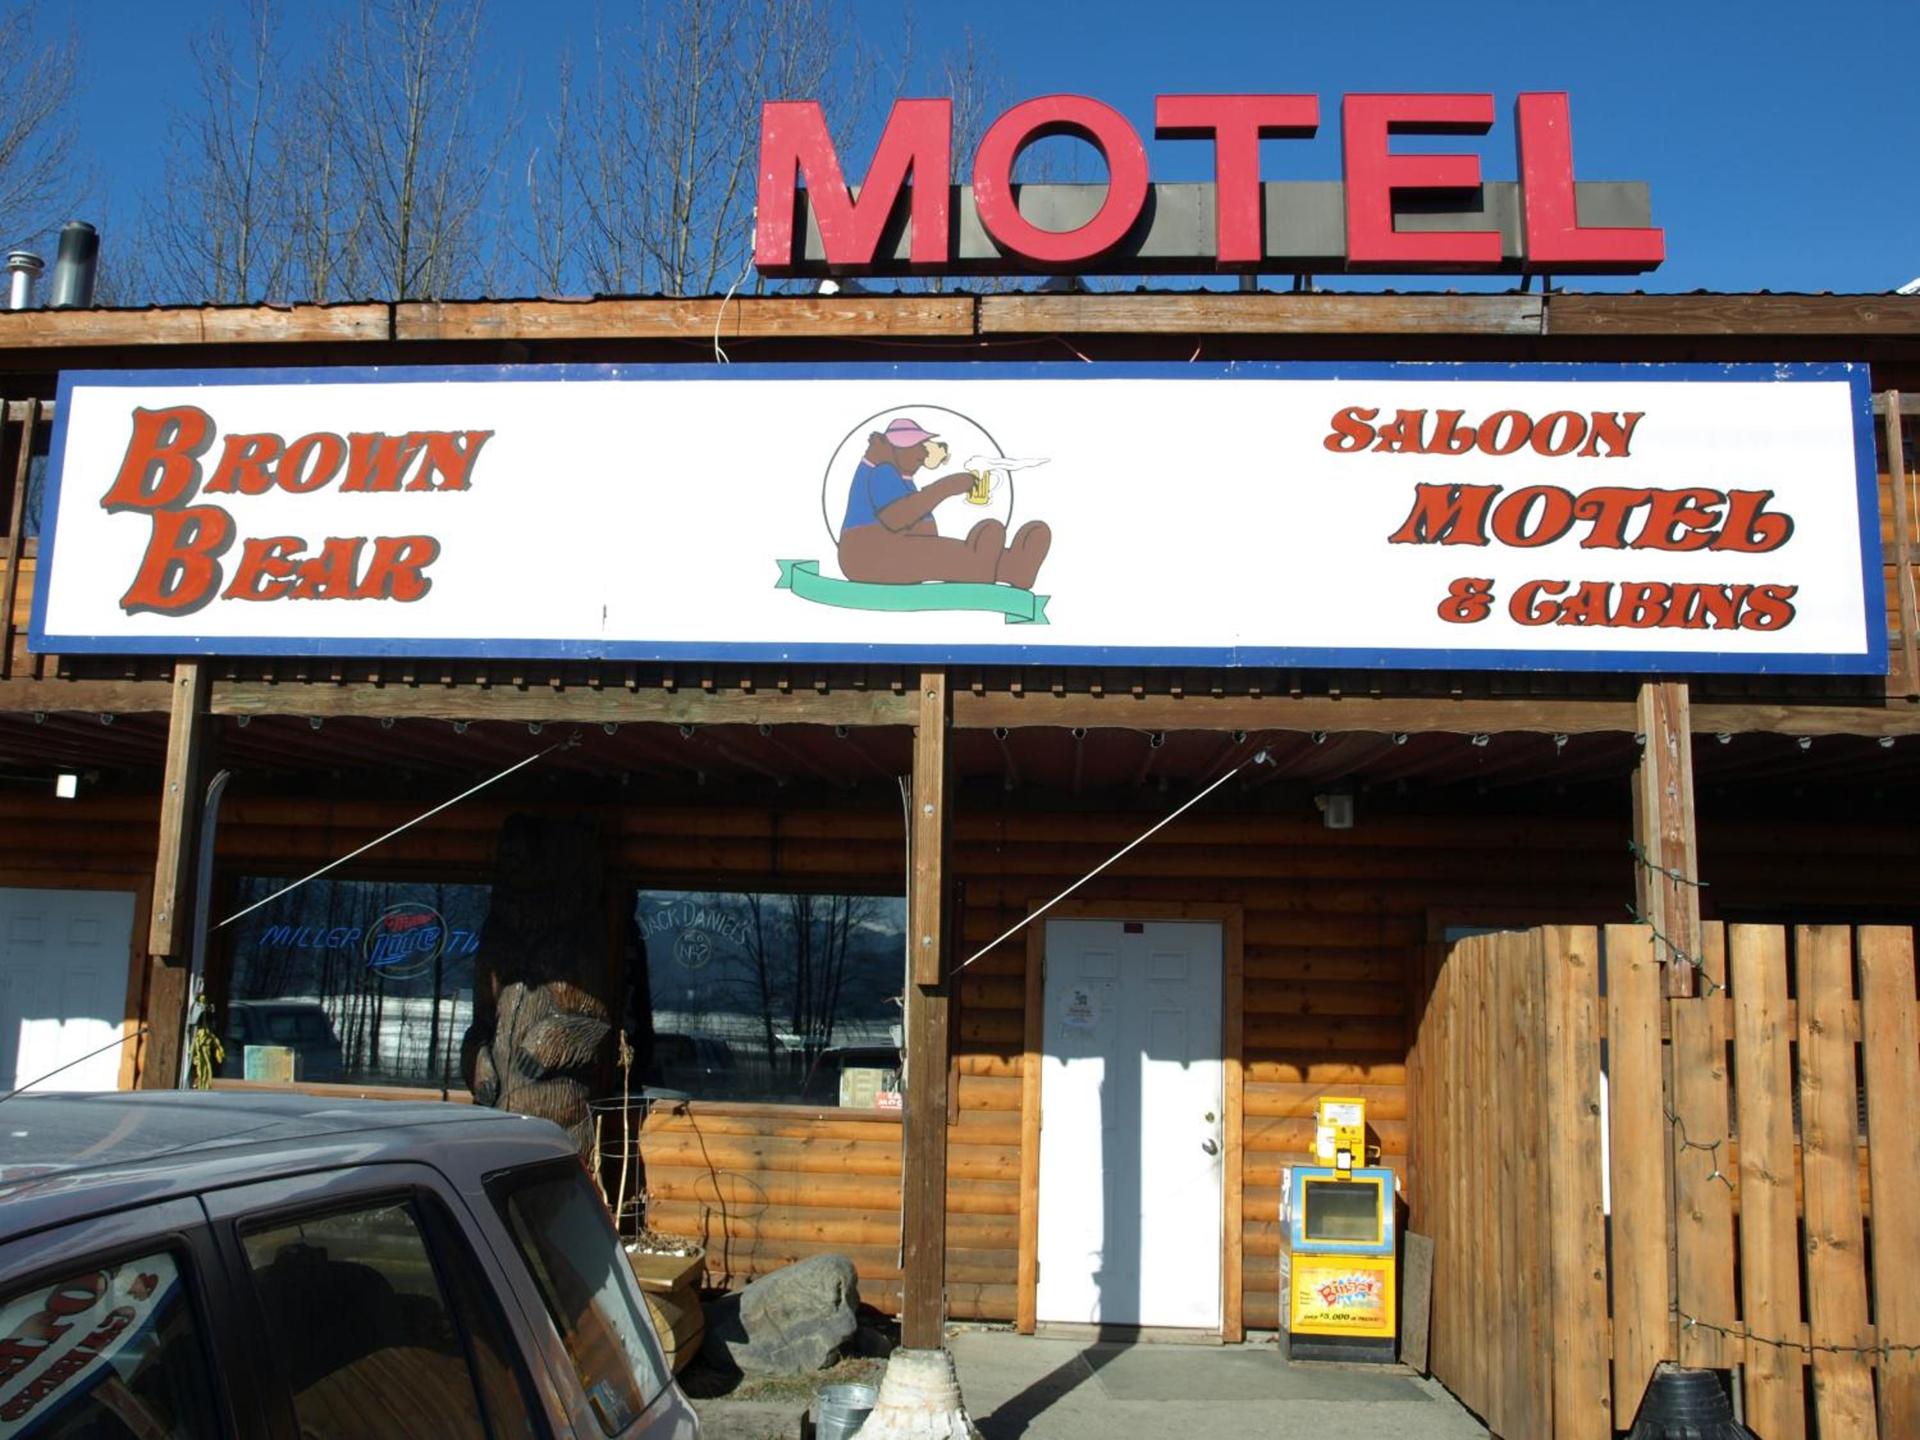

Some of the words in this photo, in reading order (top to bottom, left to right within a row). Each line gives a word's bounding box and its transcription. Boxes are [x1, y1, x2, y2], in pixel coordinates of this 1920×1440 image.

[754, 92, 1665, 277] MOTEL
[100, 405, 496, 515] BROWN
[1322, 406, 1646, 458] SALOON
[1387, 482, 1795, 554] MOTEL
[118, 503, 441, 617] BEAR
[1437, 576, 1496, 625] &
[1508, 579, 1800, 632] CABINS
[259, 924, 362, 950] MILLER
[638, 907, 681, 941] JACK
